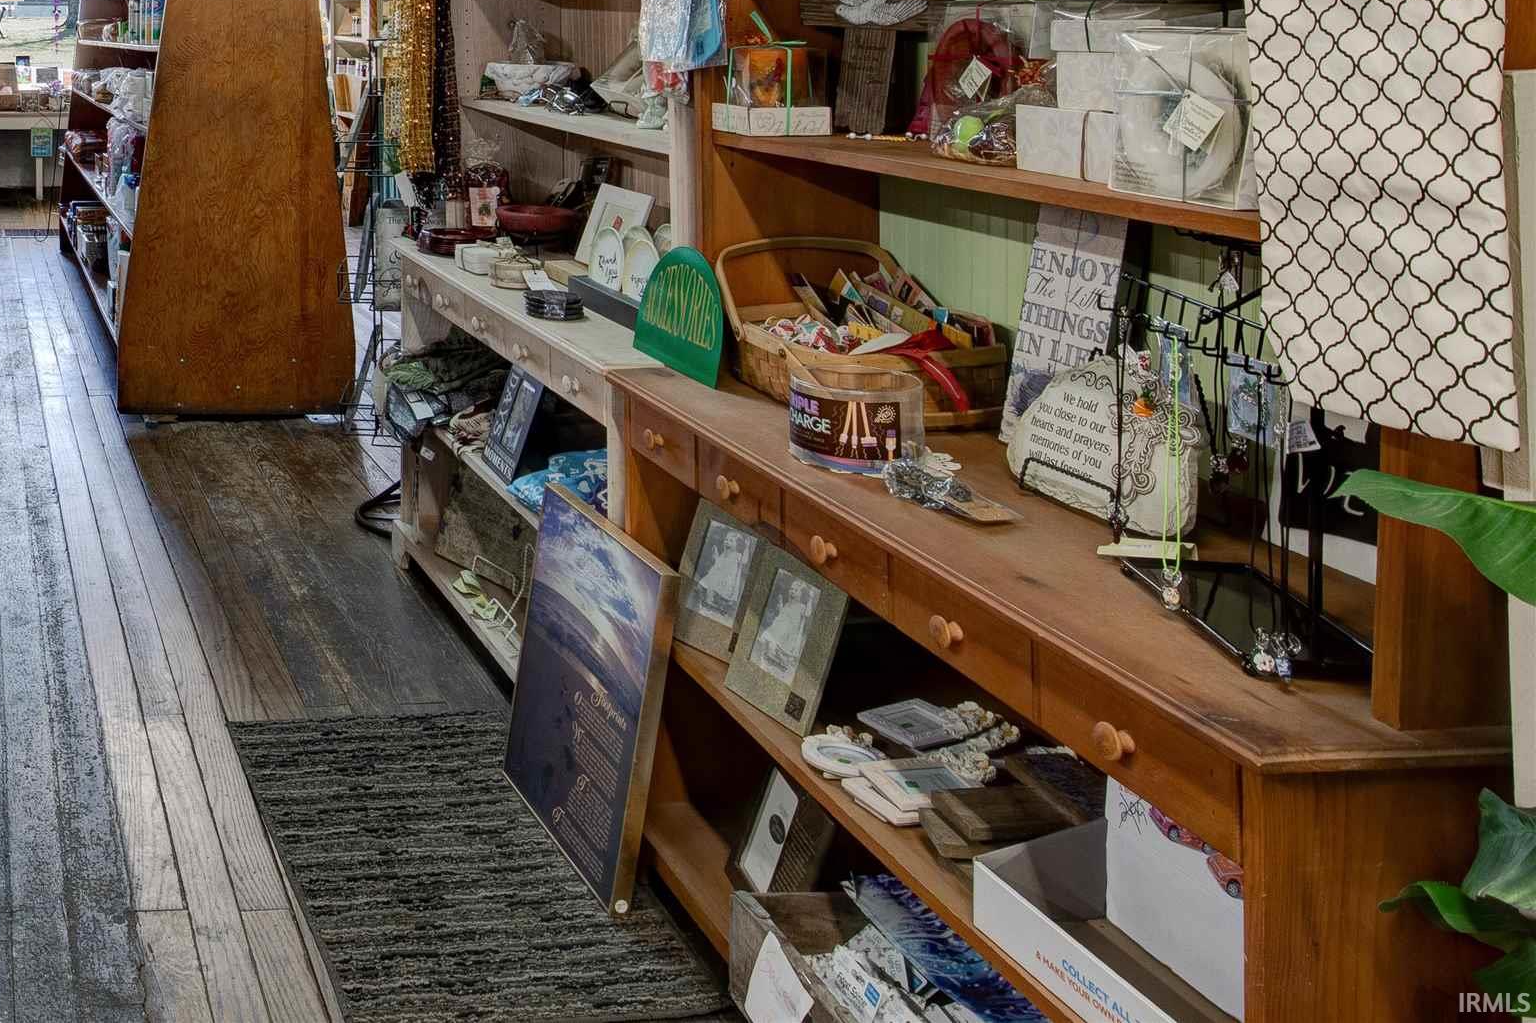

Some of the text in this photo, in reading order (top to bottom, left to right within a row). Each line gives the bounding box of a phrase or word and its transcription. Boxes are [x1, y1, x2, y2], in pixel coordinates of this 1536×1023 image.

[1030, 247, 1121, 287] ENJOY
[1027, 271, 1056, 299] The
[1023, 299, 1110, 345] THINGS
[1016, 328, 1094, 369] IN LIF
[790, 391, 821, 417] RIPLE
[1037, 401, 1107, 434] you close to our
[1063, 391, 1099, 414] We hold
[1030, 414, 1055, 433] hearts
[1055, 425, 1074, 440] and
[1030, 433, 1103, 469] memories of you
[1062, 958, 1110, 1004] COLLECT
[1066, 979, 1091, 1002] YOUR
